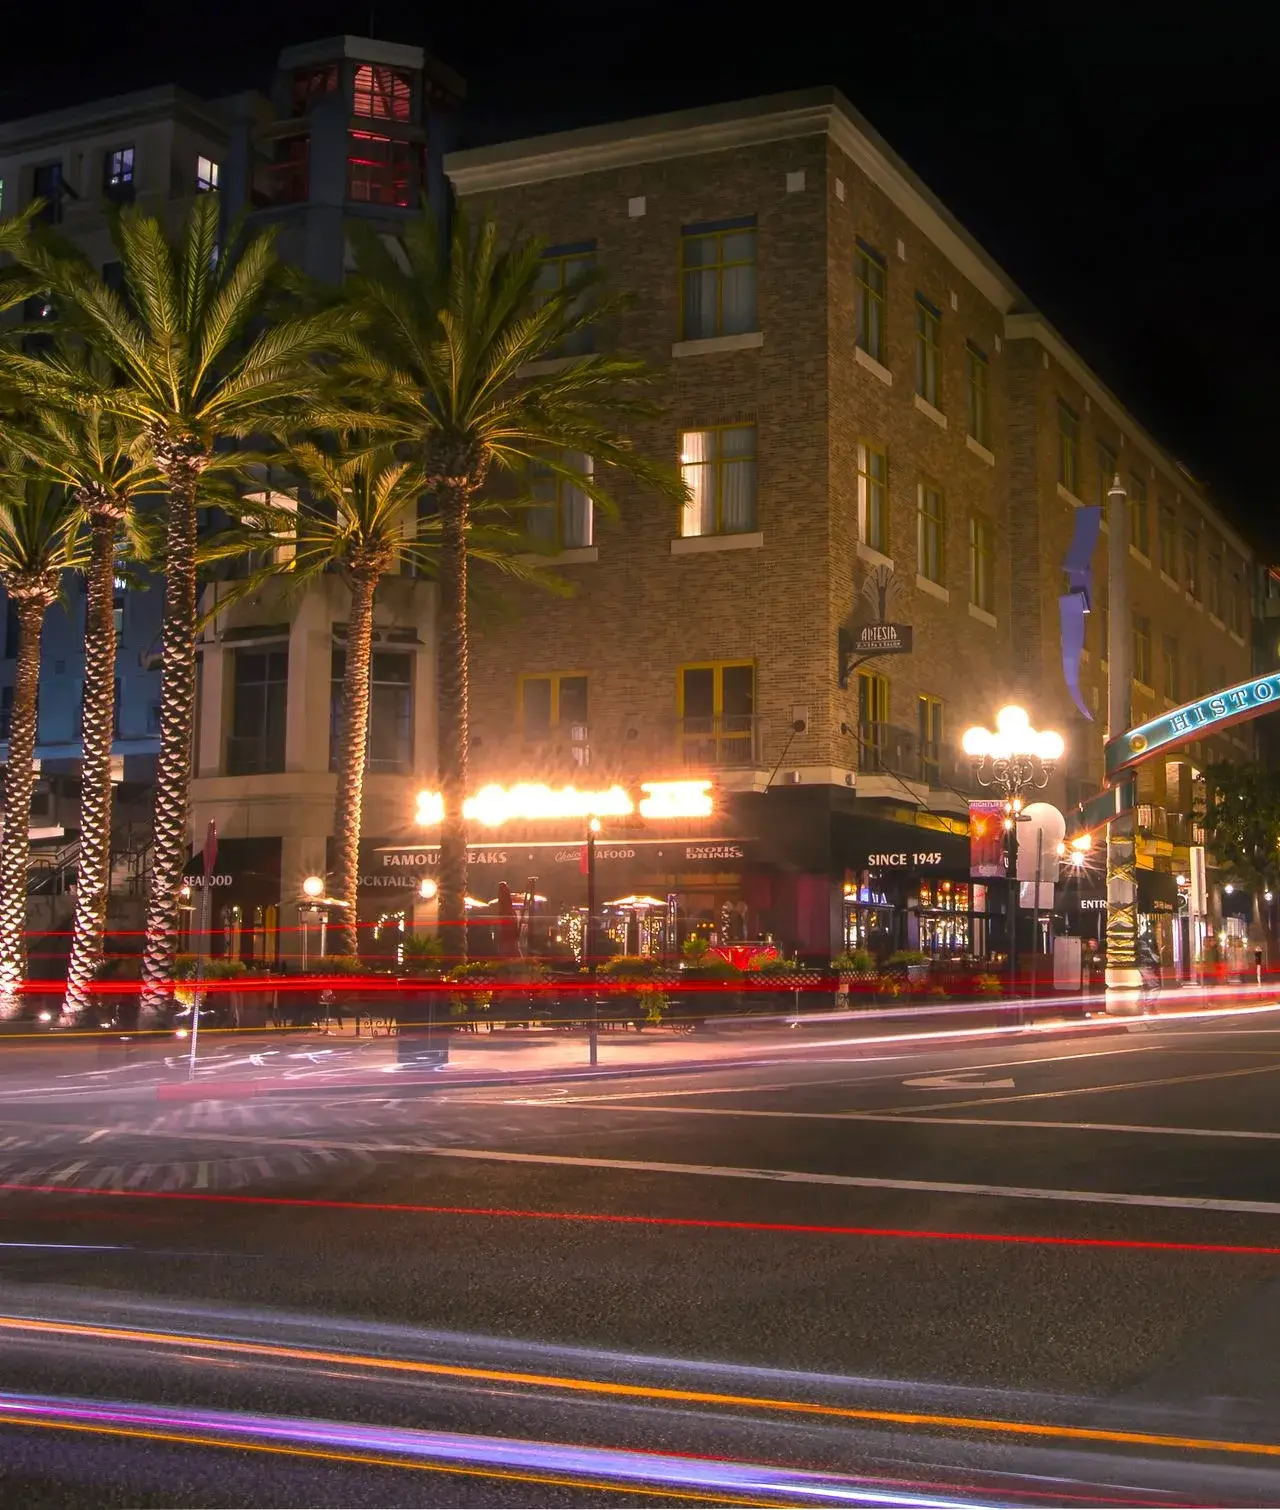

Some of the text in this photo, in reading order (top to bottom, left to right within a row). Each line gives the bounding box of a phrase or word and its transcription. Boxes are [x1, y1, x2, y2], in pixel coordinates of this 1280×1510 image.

[383, 853, 441, 866] FAMOU
[686, 852, 744, 860] DRINKS
[868, 852, 942, 866] SINCE 1945
